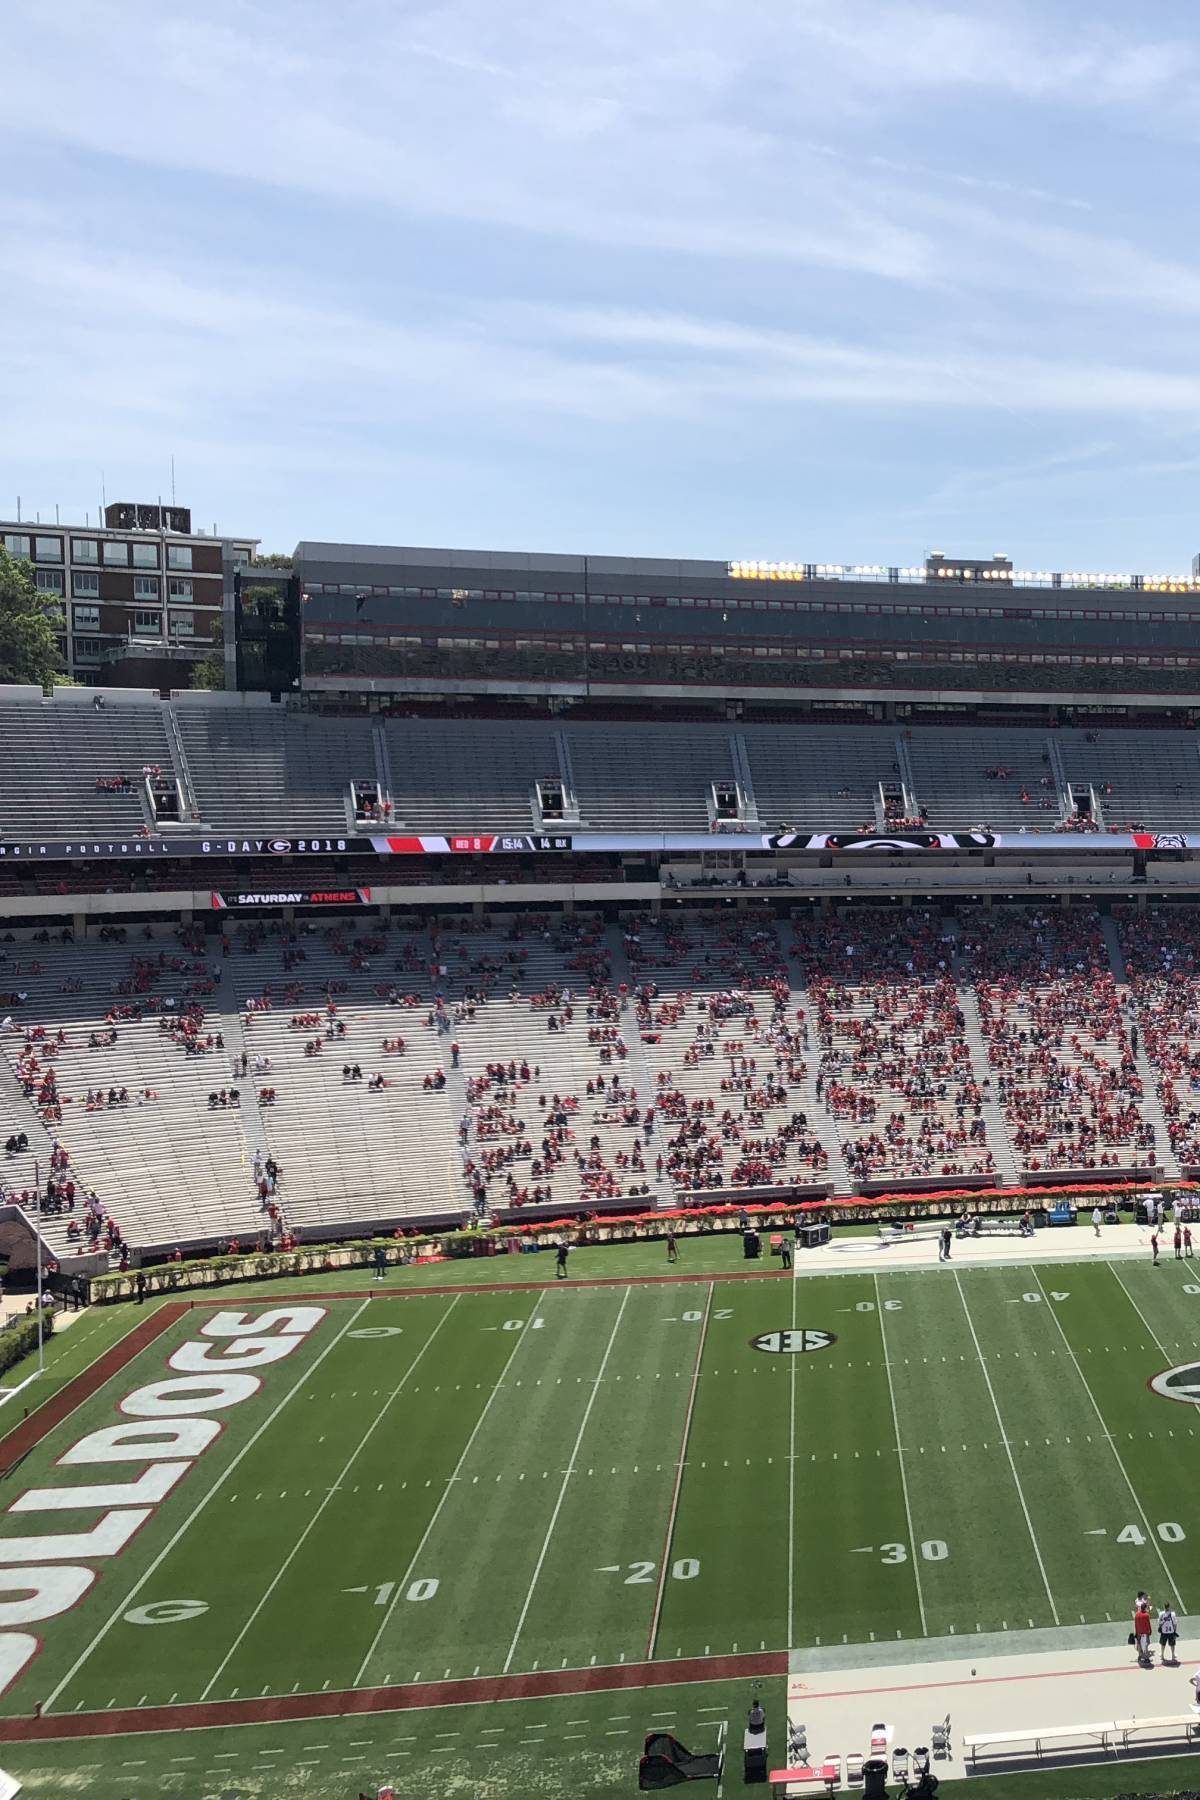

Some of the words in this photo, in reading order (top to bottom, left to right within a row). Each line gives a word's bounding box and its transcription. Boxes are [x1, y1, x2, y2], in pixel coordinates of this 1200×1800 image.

[66, 845, 168, 854] FOOTBALL
[202, 841, 263, 852] G-DAY
[297, 840, 346, 851] 2018
[474, 839, 480, 849] 8
[541, 838, 550, 848] 14
[238, 894, 302, 903] SATURDAY
[310, 892, 356, 903] ATHENS
[855, 1300, 903, 1312] 30
[1021, 1291, 1071, 1303] 40
[682, 1308, 735, 1322] 20
[502, 1318, 546, 1331] 10
[756, 1330, 832, 1352] SEC
[0, 1306, 327, 1700] ULLDOGS
[1116, 1522, 1186, 1546] 40
[879, 1539, 949, 1564] 30
[623, 1558, 701, 1584] 20
[374, 1578, 440, 1605] 10
[123, 1600, 211, 1625] G
